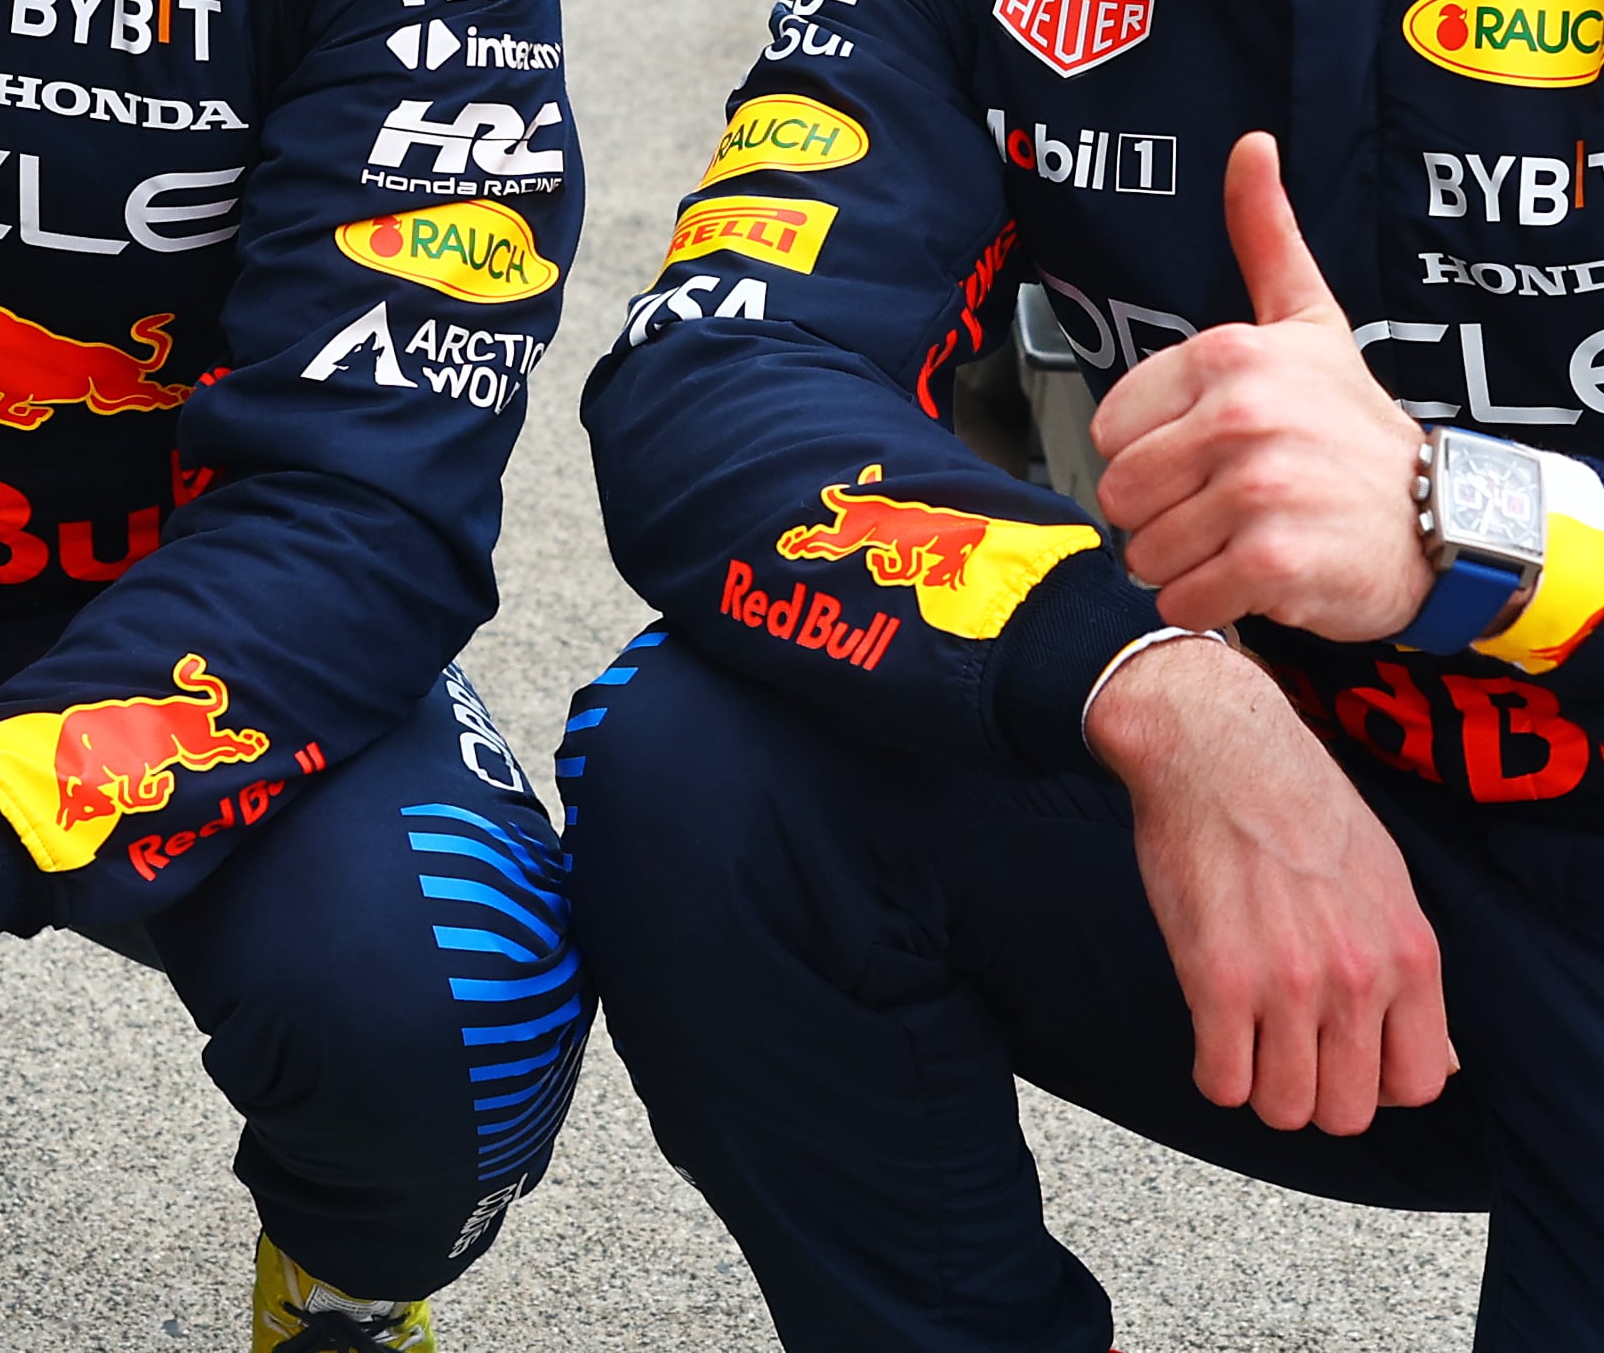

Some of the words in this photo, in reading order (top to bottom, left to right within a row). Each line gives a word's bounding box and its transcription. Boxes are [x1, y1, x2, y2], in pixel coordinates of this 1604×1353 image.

[367, 99, 564, 176] HRC
[361, 169, 478, 196] Honda
[410, 217, 529, 285] RAUCH
[667, 219, 798, 255] RELLI
[720, 559, 807, 641] Red
[796, 591, 901, 671] Bull
[1271, 661, 1443, 783] ed
[239, 741, 327, 826] Bll
